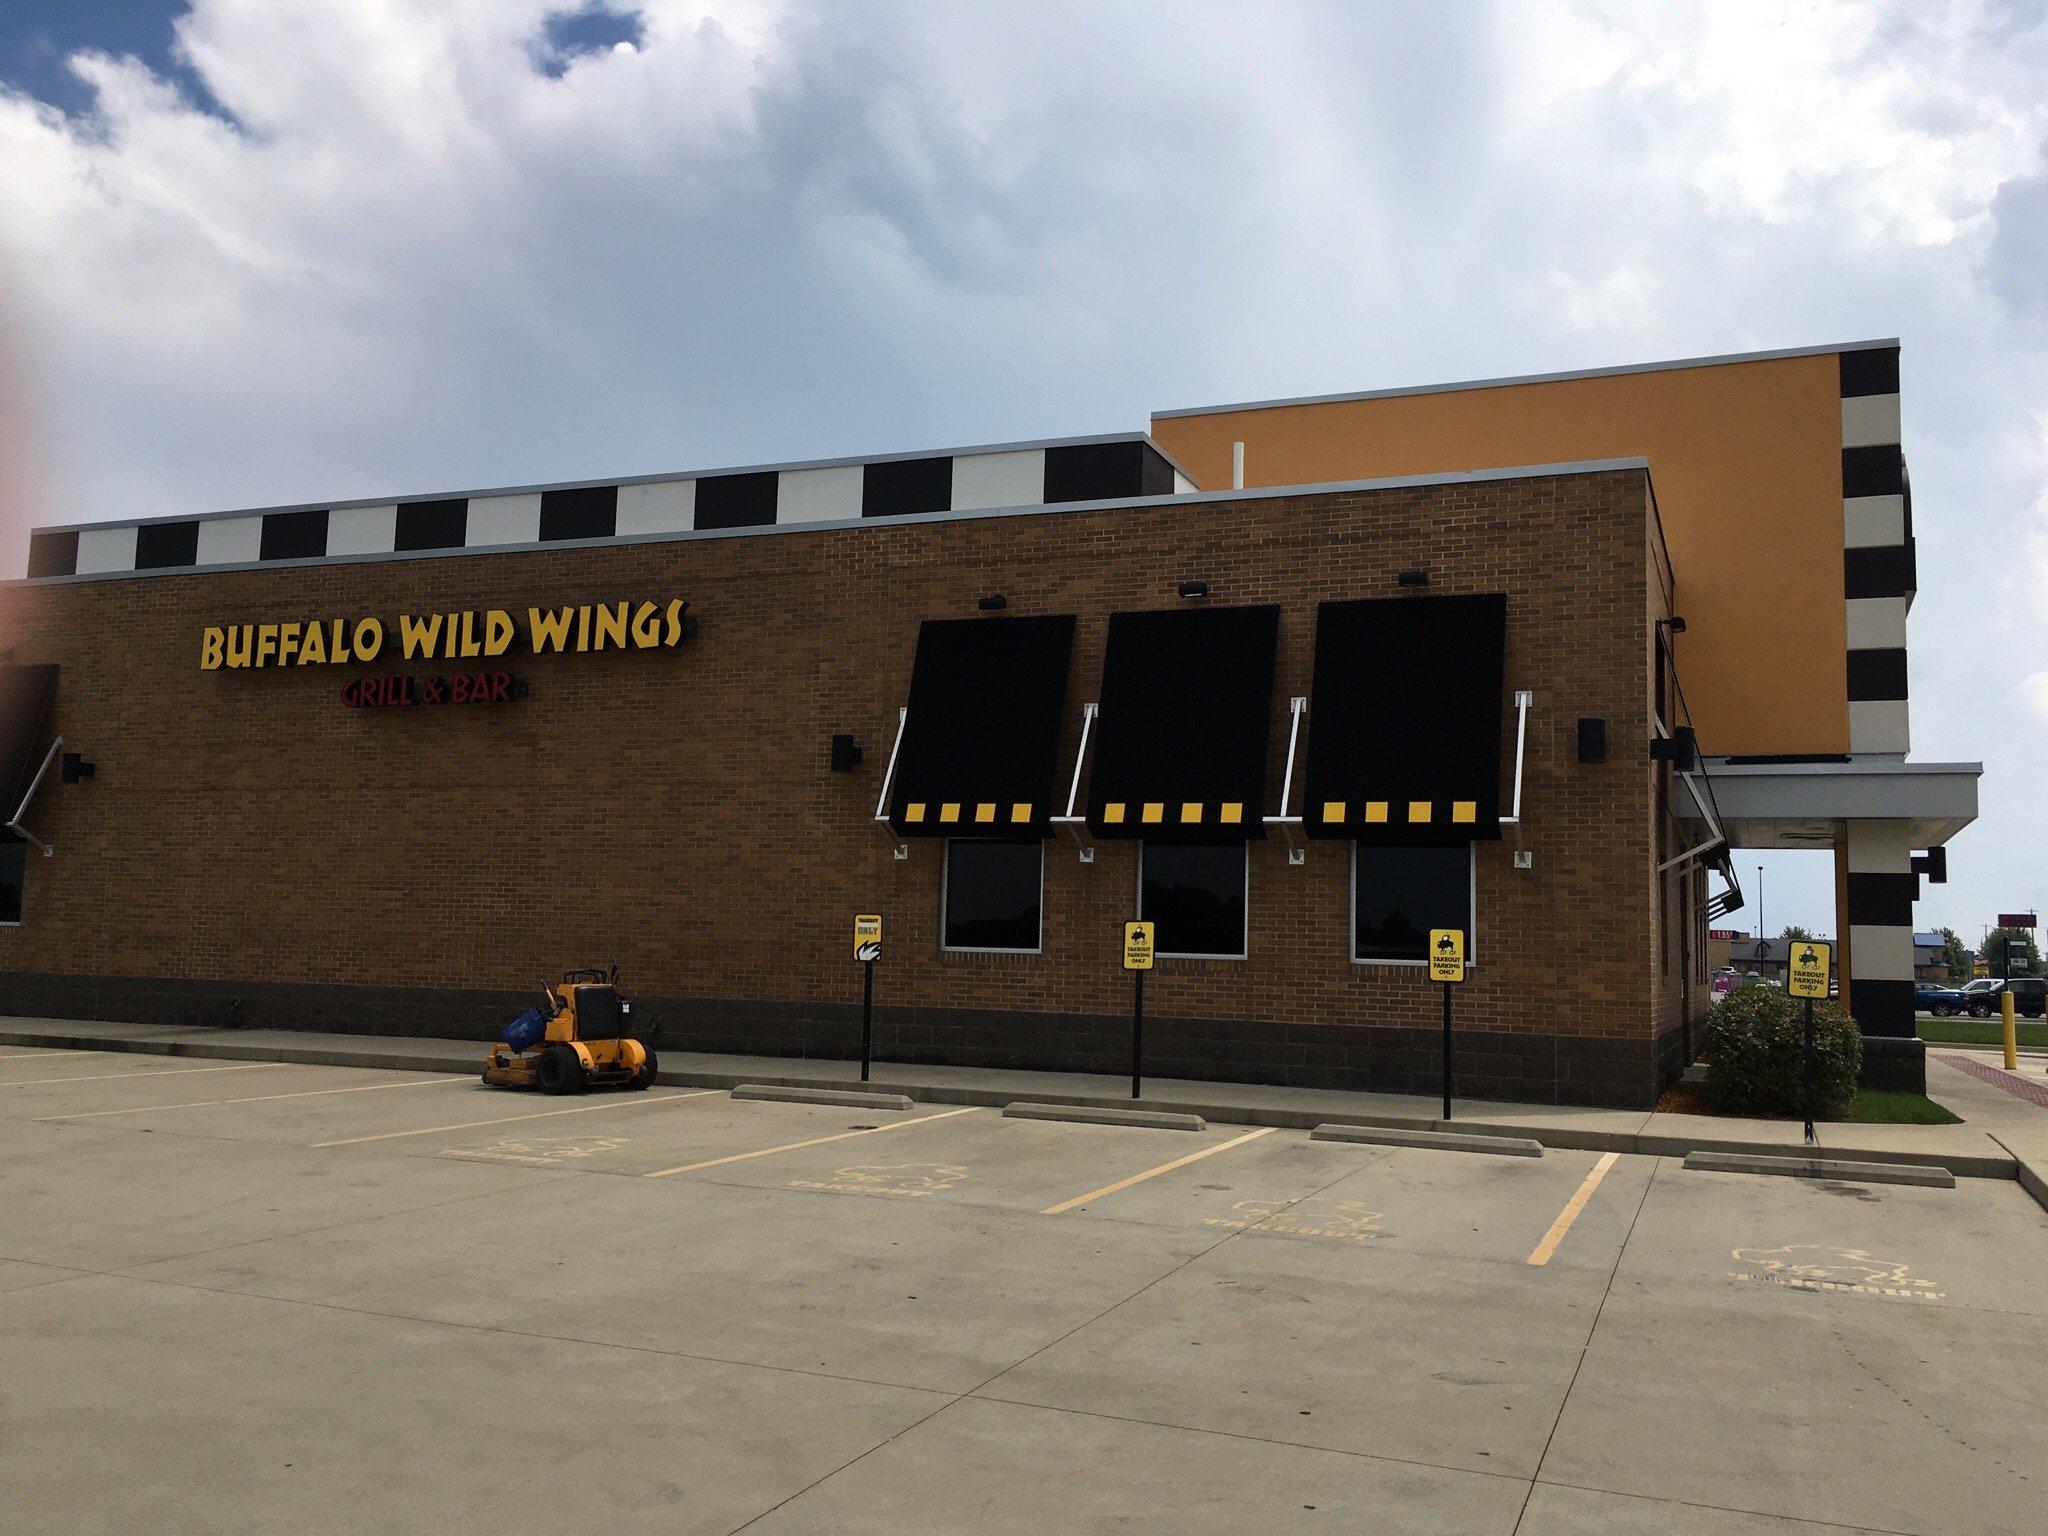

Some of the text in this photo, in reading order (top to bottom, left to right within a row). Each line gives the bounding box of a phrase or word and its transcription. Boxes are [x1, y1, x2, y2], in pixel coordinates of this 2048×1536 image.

[201, 599, 684, 669] BUFFALO WILD WINGS
[340, 671, 511, 707] GRILL & BAR
[857, 927, 878, 935] ONLY
[1793, 970, 1826, 978] TAKEOUT
[1793, 977, 1825, 985] PARKING
